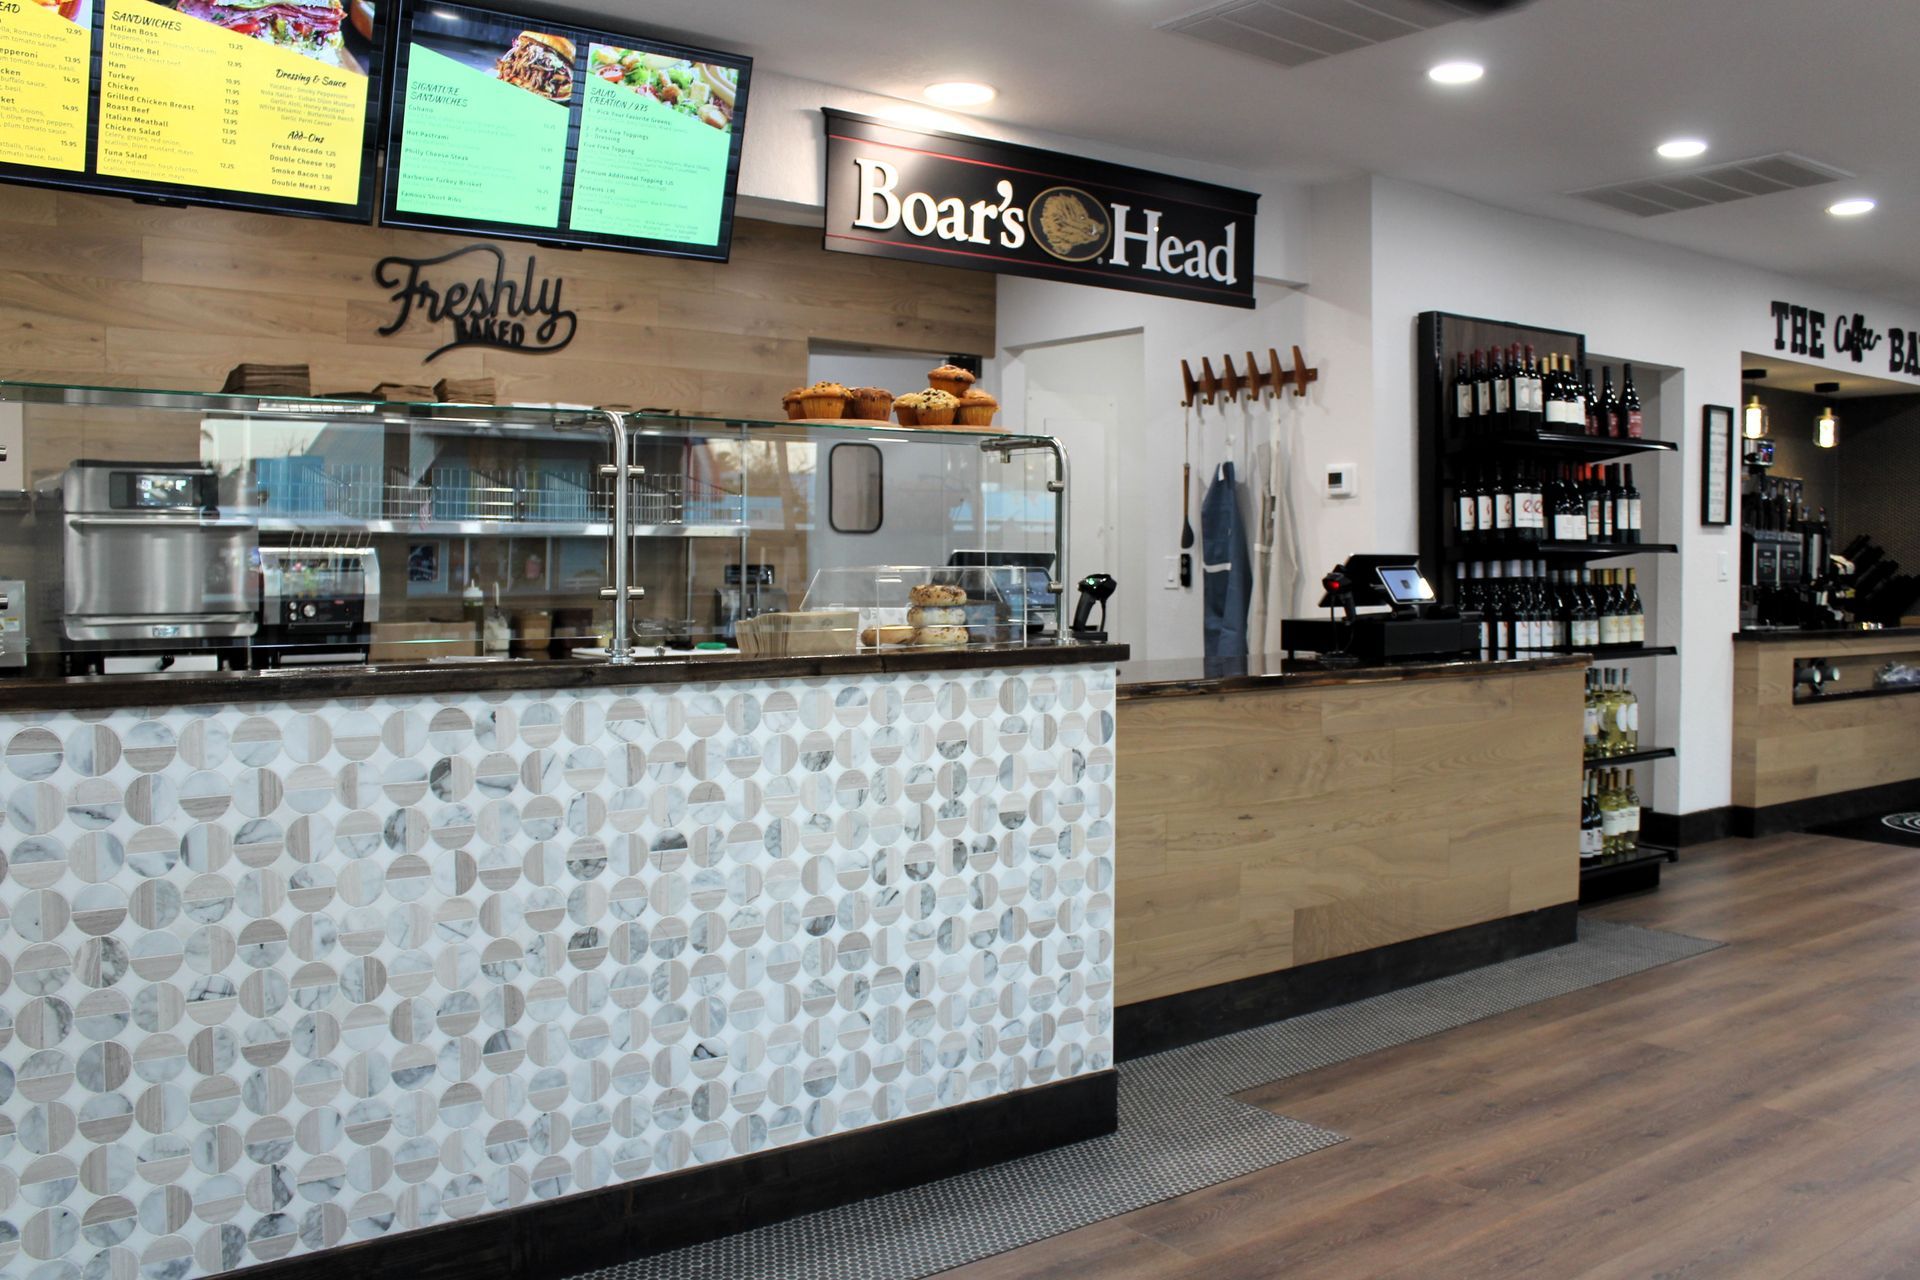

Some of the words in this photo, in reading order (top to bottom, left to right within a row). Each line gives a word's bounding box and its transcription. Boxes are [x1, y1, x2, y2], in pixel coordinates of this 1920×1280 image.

[111, 10, 182, 32] SANDWICHES
[110, 24, 137, 34] Italian
[139, 29, 158, 38] Boss
[109, 42, 144, 53] Ultimate
[108, 61, 126, 69] Ham
[108, 71, 135, 81] Turkey
[275, 68, 311, 86] Dressing
[312, 74, 320, 84] &
[321, 76, 347, 88] Sauce
[107, 82, 139, 92] Chicken
[410, 81, 460, 96] SIGNATURE
[590, 87, 616, 98] SALAD
[1, 96, 15, 104] ket
[107, 92, 134, 102] Grilled
[136, 96, 168, 107] Chicken
[169, 101, 195, 111] Breast
[410, 91, 469, 107] SANDWICHES
[589, 96, 628, 109] CREATION
[106, 102, 129, 112] Roast
[131, 106, 150, 114] Beef
[105, 112, 132, 123] Italian
[134, 116, 169, 127] Meatball
[105, 123, 137, 133] Chicken
[138, 127, 161, 136] Salad
[287, 130, 325, 144] Add-Ons
[104, 149, 123, 157] Tuna
[125, 151, 148, 160] Salad
[271, 142, 291, 151] Fresh
[292, 145, 323, 155] Avocado
[269, 154, 296, 163] Double
[297, 158, 323, 167] Cheese
[271, 167, 296, 175] Smoke
[297, 170, 319, 178] Bacon
[271, 178, 297, 188] Double
[299, 182, 317, 190] Meat
[854, 158, 1026, 249] Boar's
[1110, 202, 1237, 286] Head
[372, 243, 577, 360] Freshly
[456, 311, 525, 347] BAKED
[1770, 300, 1826, 359] THE
[1888, 328, 1920, 376] BA
